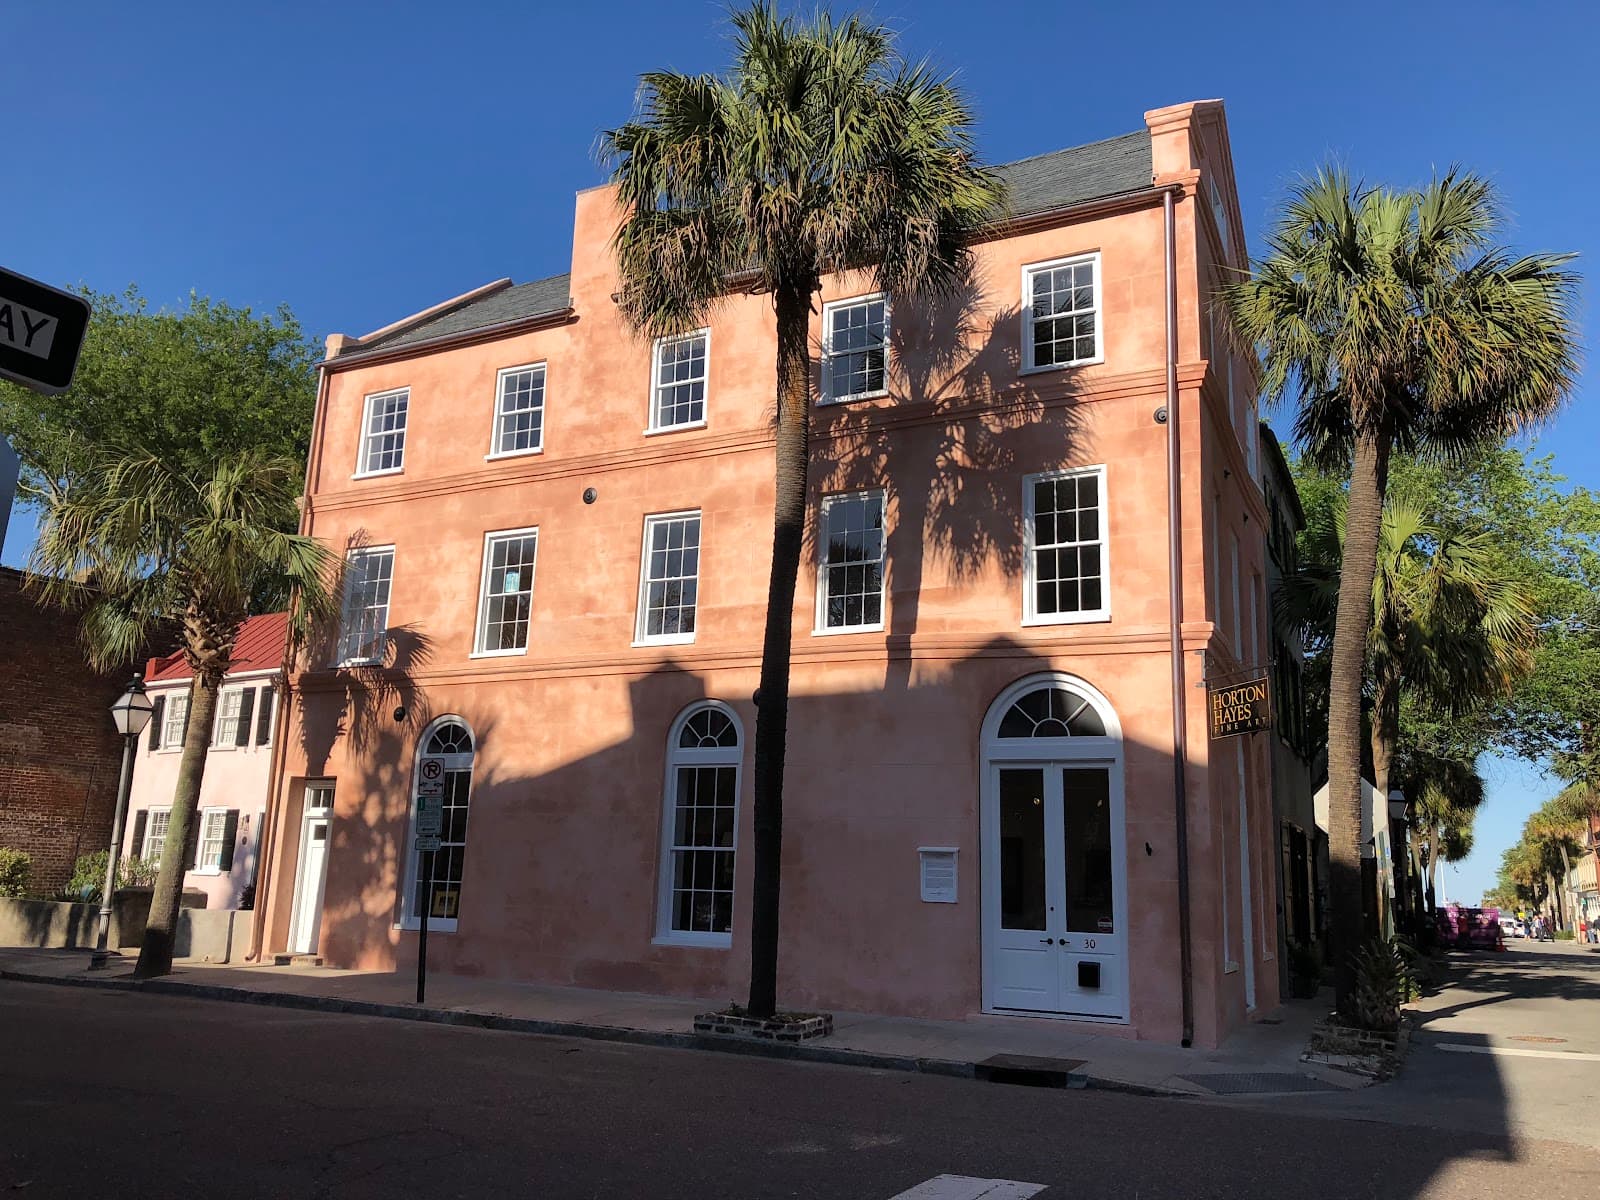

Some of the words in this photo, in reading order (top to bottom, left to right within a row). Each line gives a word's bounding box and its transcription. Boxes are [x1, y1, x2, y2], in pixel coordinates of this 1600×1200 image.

[1213, 684, 1265, 710] HORTON
[1213, 703, 1252, 726] HAYES
[1214, 722, 1239, 734] FINE
[1247, 716, 1267, 728] ART
[1083, 939, 1096, 949] 30
